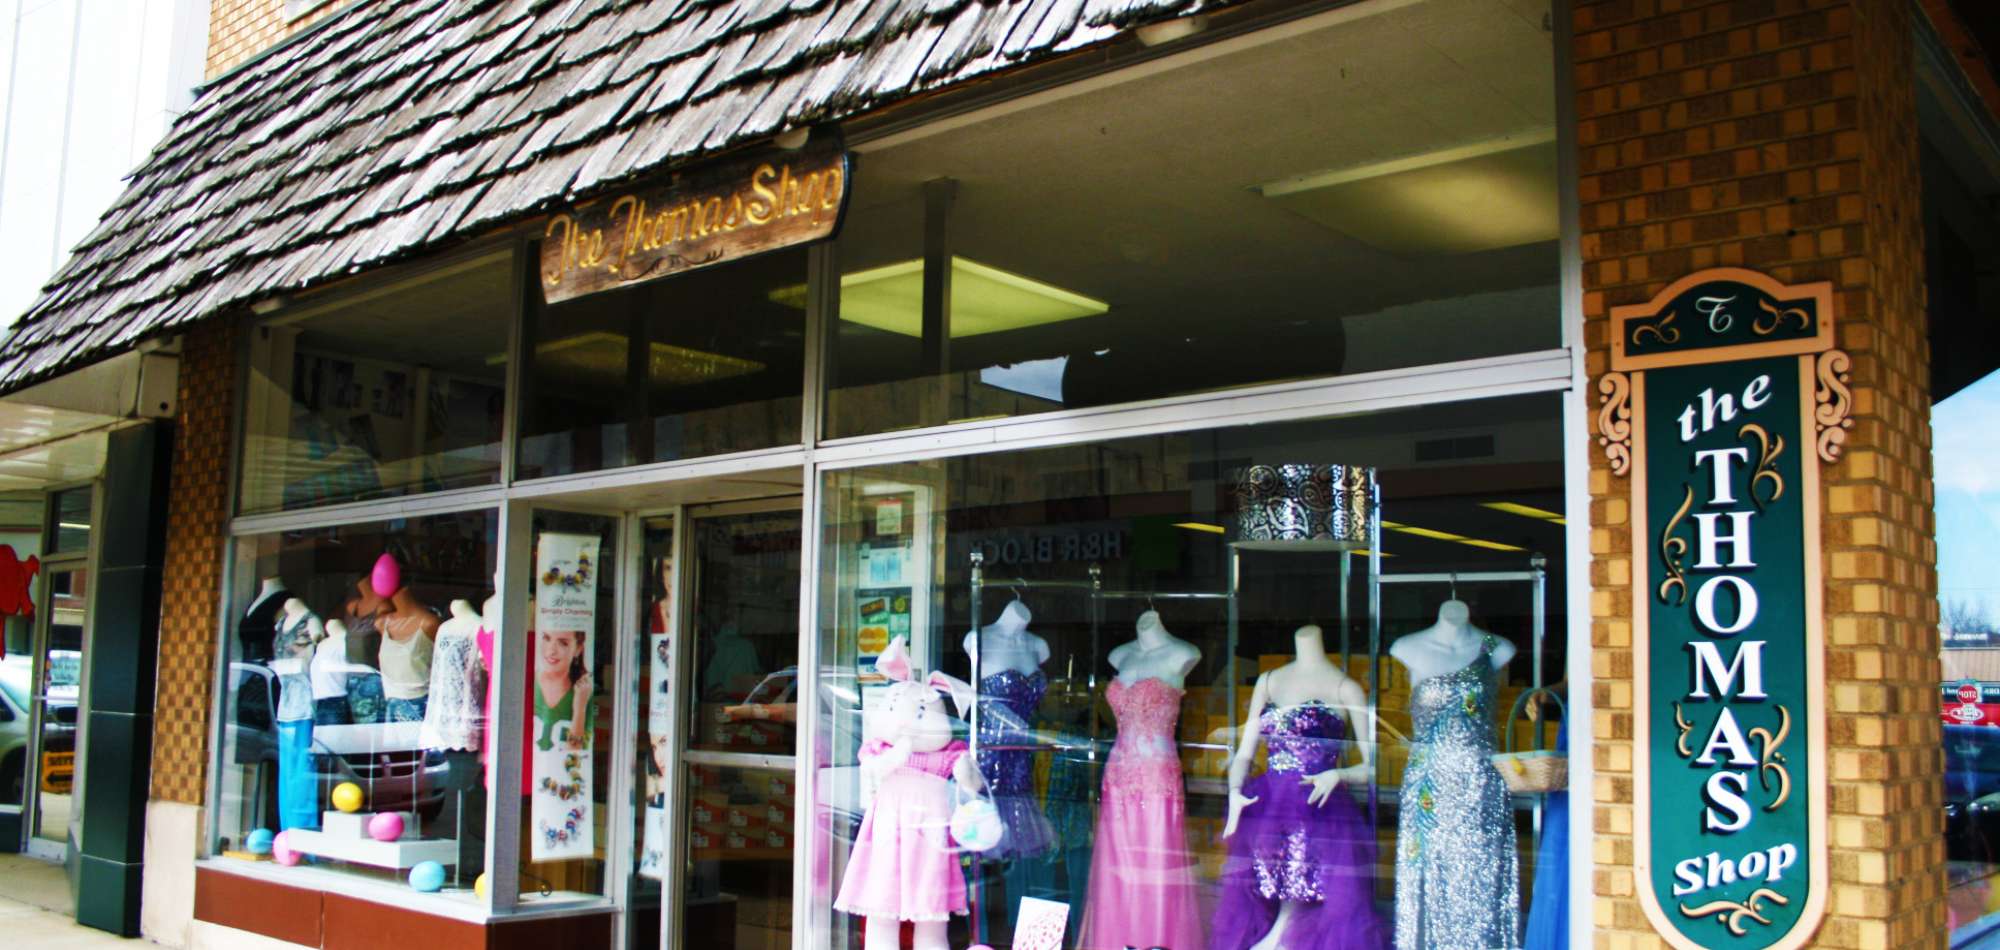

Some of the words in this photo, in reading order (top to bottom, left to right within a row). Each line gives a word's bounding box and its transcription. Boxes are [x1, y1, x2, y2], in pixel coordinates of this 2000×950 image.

[545, 213, 603, 285] The
[608, 194, 742, 273] Thomas
[746, 162, 841, 226] Shop
[1676, 373, 1773, 443] the
[1687, 446, 1768, 833] THOMAS
[1672, 842, 1798, 898] Shop
